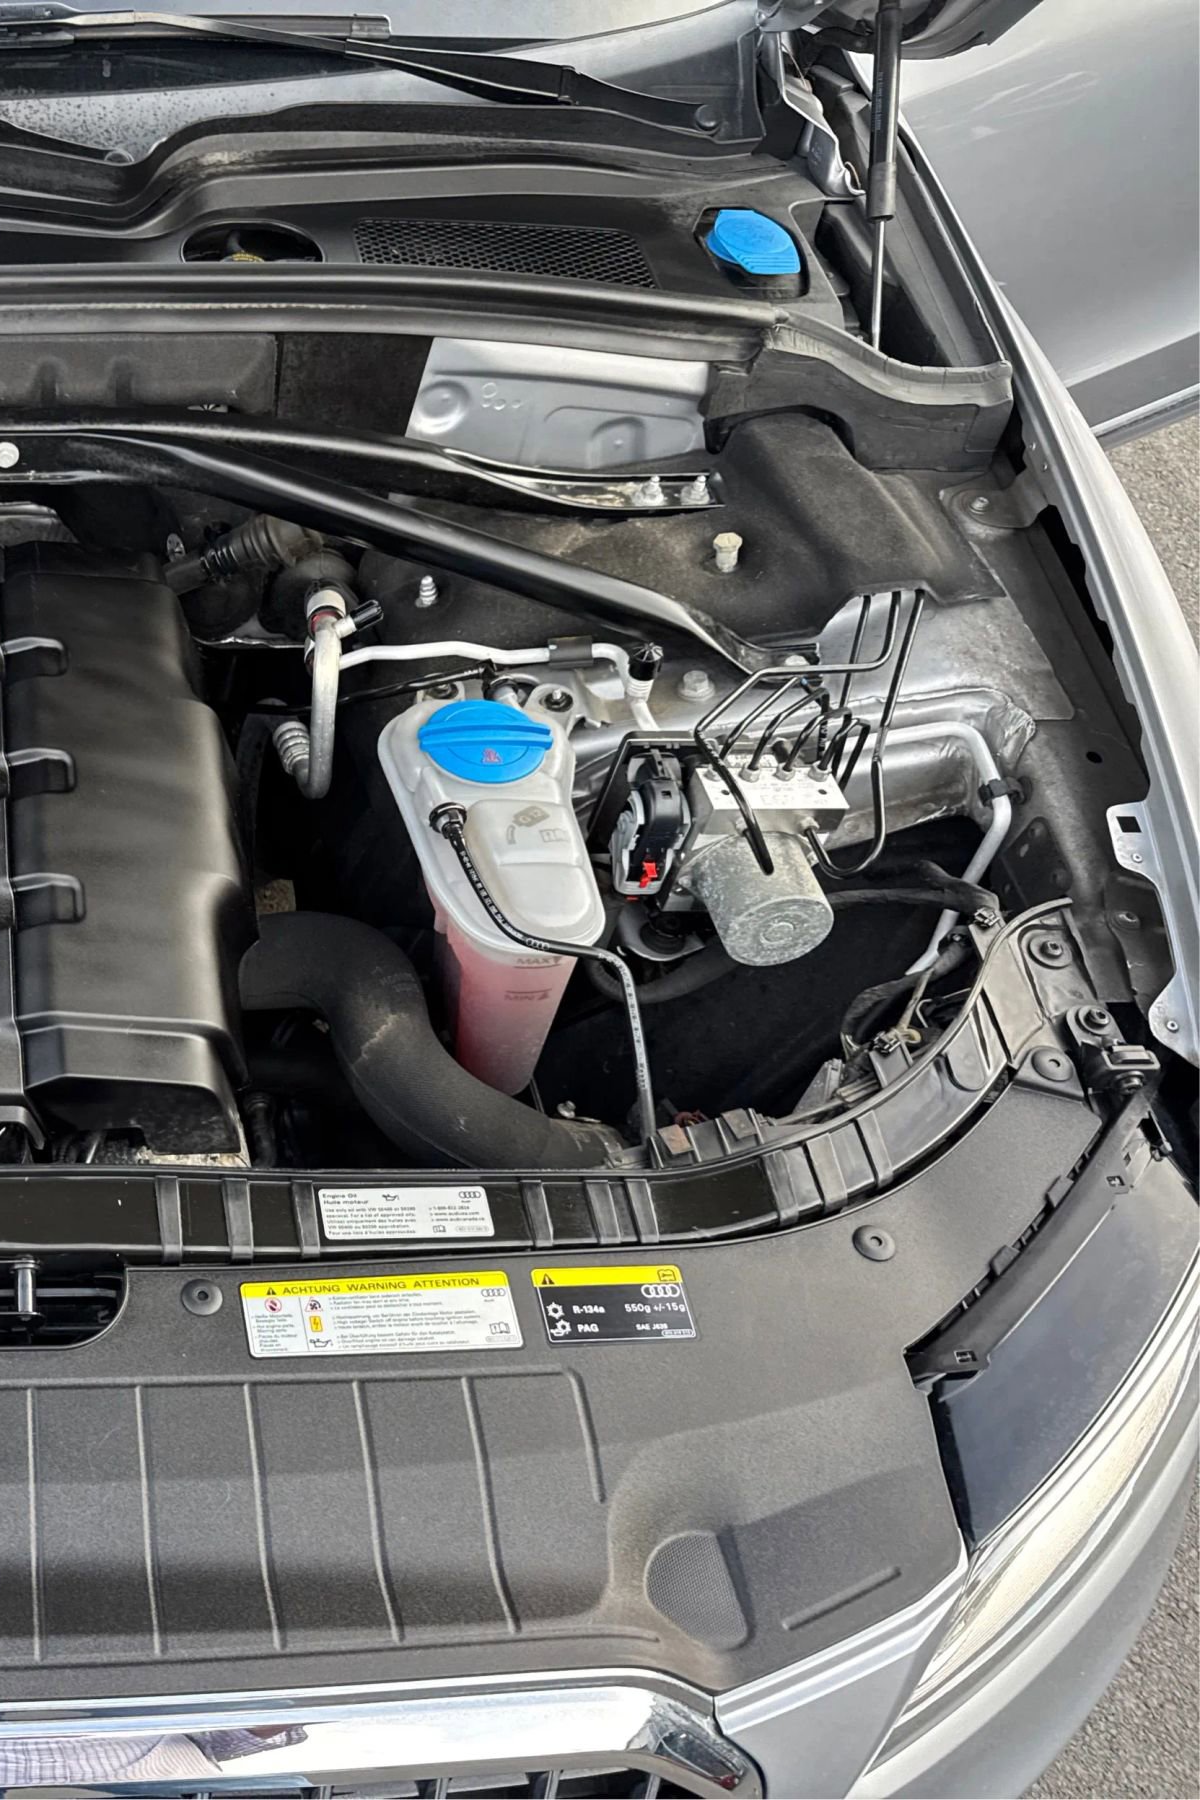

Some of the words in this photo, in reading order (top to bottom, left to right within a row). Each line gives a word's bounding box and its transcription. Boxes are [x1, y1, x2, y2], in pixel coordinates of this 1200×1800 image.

[282, 1284, 341, 1295] ACHTUNG
[346, 1281, 407, 1292] WARNING
[413, 1278, 480, 1288] ATTENTION
[572, 1305, 606, 1314] R-134a
[624, 1303, 651, 1313] 550g
[577, 1323, 599, 1333] PAG
